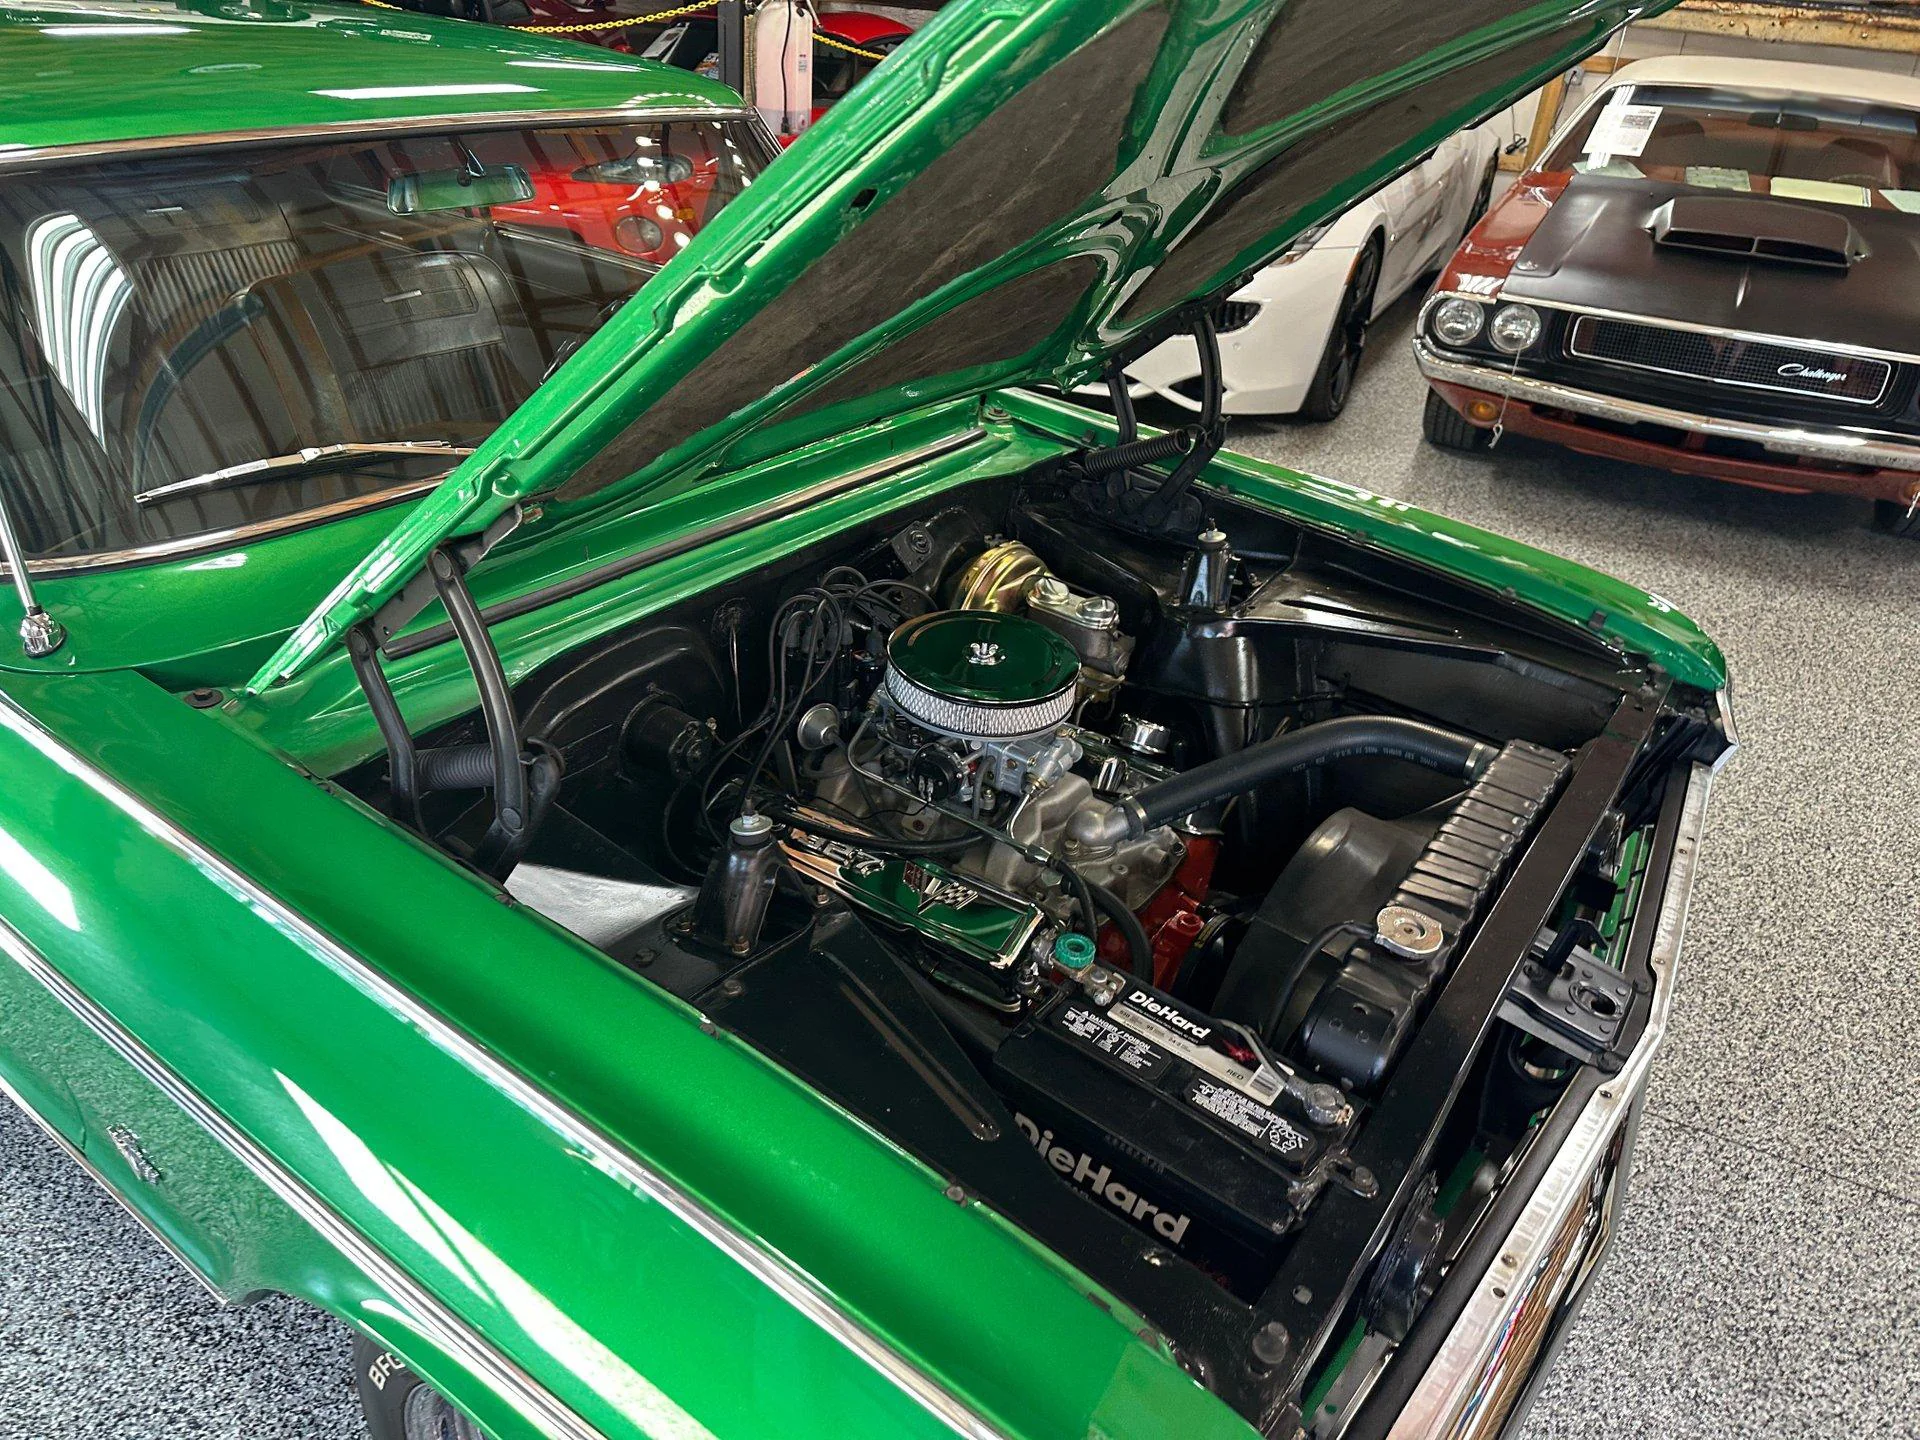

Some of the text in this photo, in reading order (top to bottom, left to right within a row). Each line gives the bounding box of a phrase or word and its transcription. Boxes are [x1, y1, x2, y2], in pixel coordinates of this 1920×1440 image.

[1777, 363, 1847, 383] Challenger
[799, 834, 886, 878] 327
[1089, 1013, 1118, 1033] DANGER
[1123, 1033, 1151, 1051] POISON
[1128, 990, 1211, 1039] DieHard
